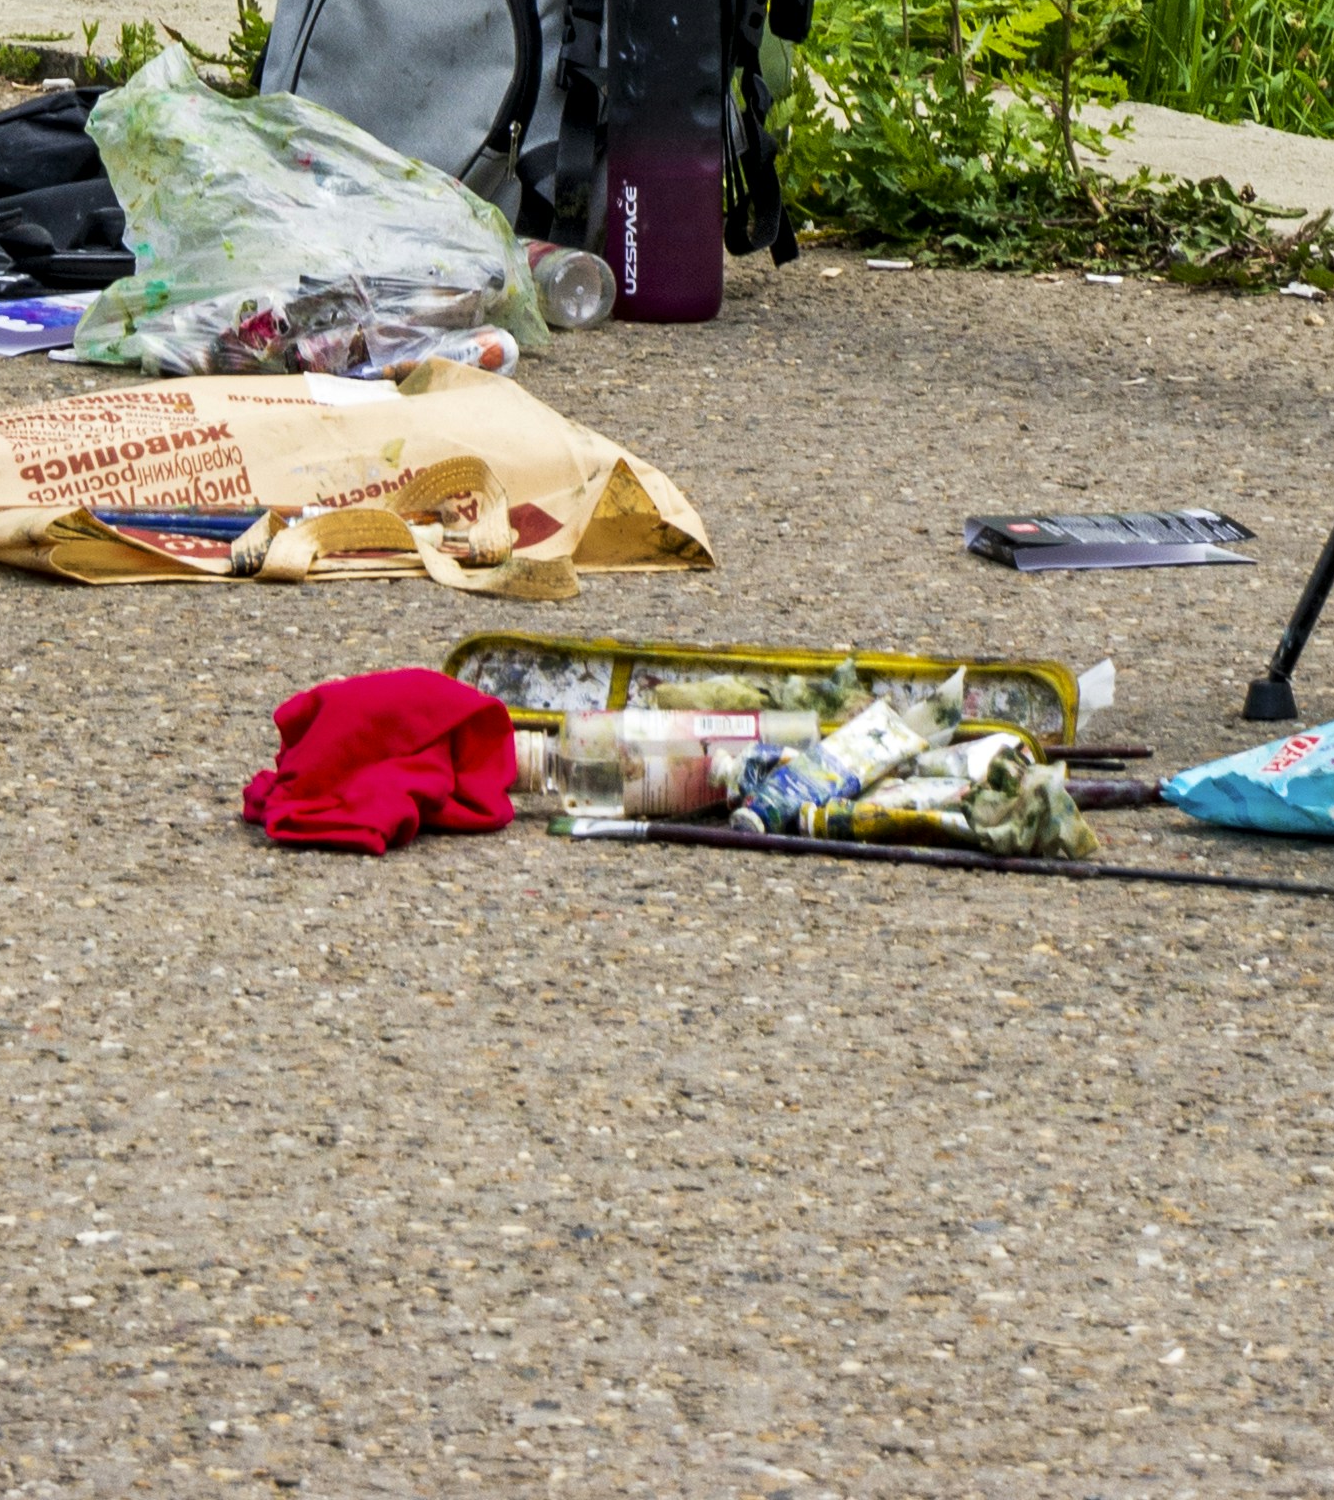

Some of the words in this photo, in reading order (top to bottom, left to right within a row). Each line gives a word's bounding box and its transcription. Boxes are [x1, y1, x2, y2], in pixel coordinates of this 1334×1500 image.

[623, 186, 638, 295] UZSPACE
[19, 422, 234, 486] живопись
[27, 461, 139, 506] роспись
